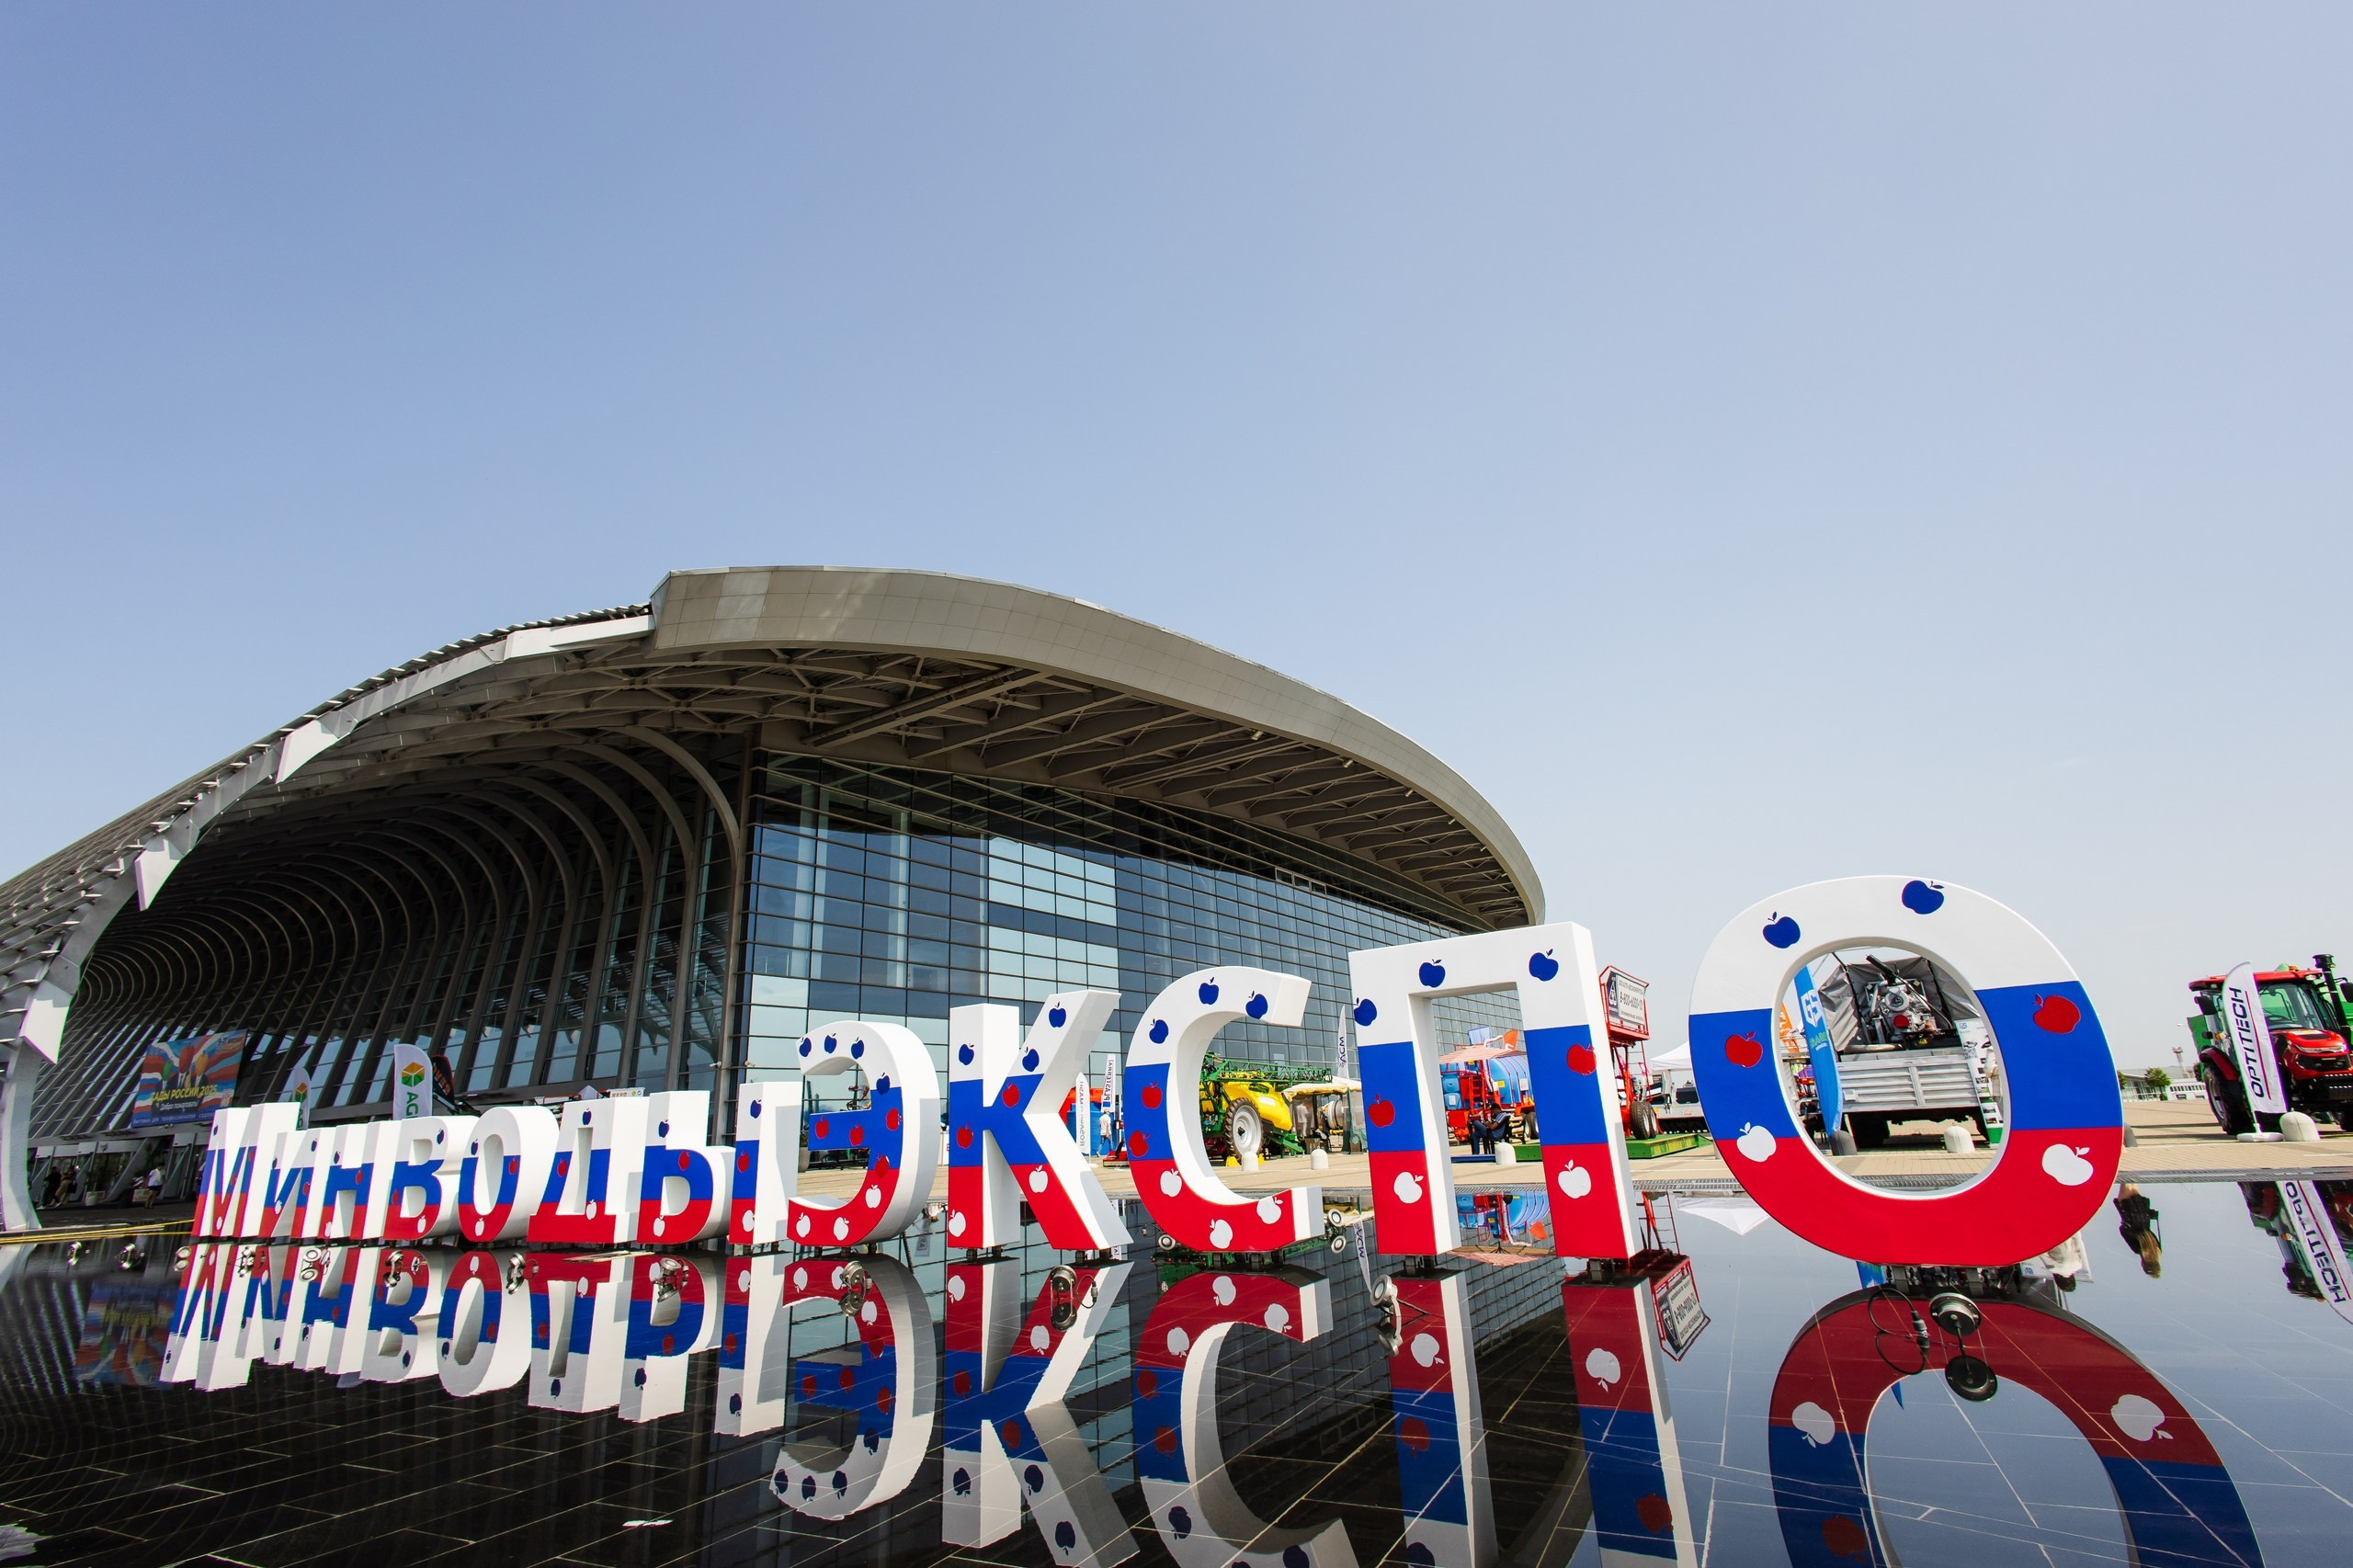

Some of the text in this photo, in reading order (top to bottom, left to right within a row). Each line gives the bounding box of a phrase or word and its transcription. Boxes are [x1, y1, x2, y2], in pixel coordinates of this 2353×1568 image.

[2229, 986, 2264, 1098] OPTITECH
[151, 1089, 169, 1102] САДЫ
[171, 1086, 199, 1100] РОССИИ
[199, 1085, 218, 1096] 2025
